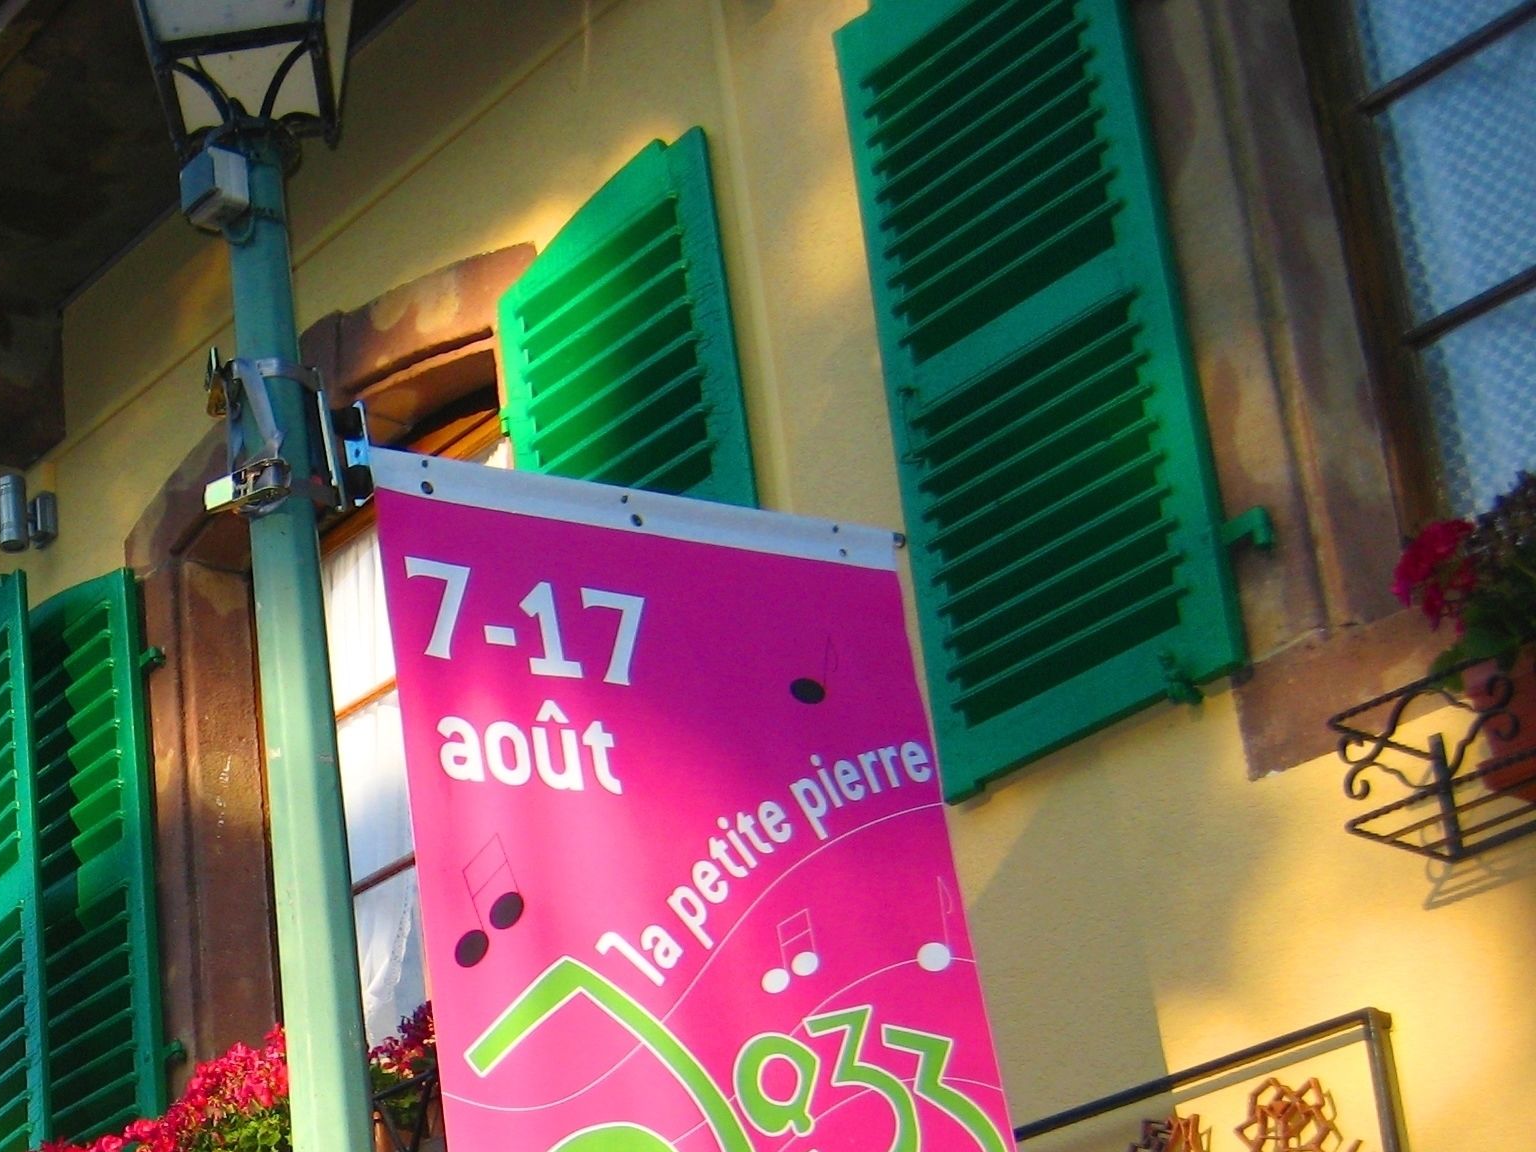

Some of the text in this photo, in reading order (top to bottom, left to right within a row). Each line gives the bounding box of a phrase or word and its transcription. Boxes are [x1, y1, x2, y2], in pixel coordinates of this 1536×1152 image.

[403, 556, 646, 687] 7-17
[436, 699, 624, 795] août
[594, 739, 933, 988] la petite pierre
